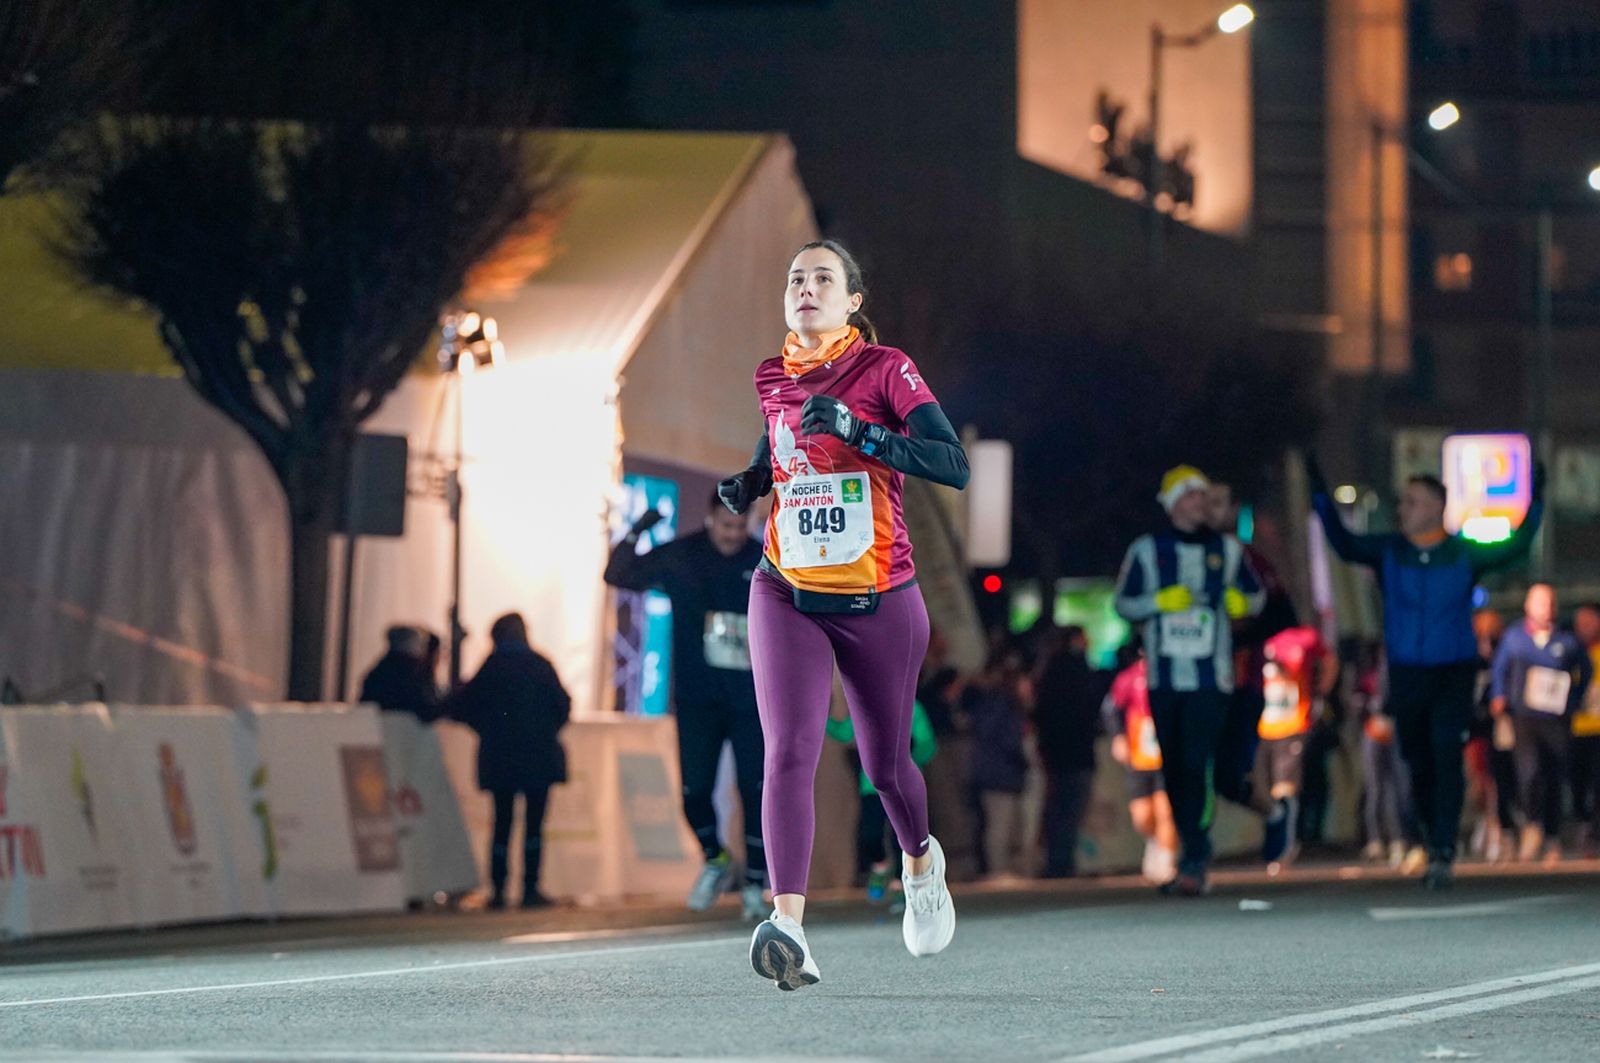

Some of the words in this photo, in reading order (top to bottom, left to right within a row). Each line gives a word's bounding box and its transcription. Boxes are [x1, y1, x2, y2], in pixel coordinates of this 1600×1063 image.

[792, 485, 821, 496] NOCHE
[822, 484, 832, 493] DE
[784, 498, 801, 508] SAN
[802, 495, 834, 507] ANTÓN
[798, 506, 846, 535] 849
